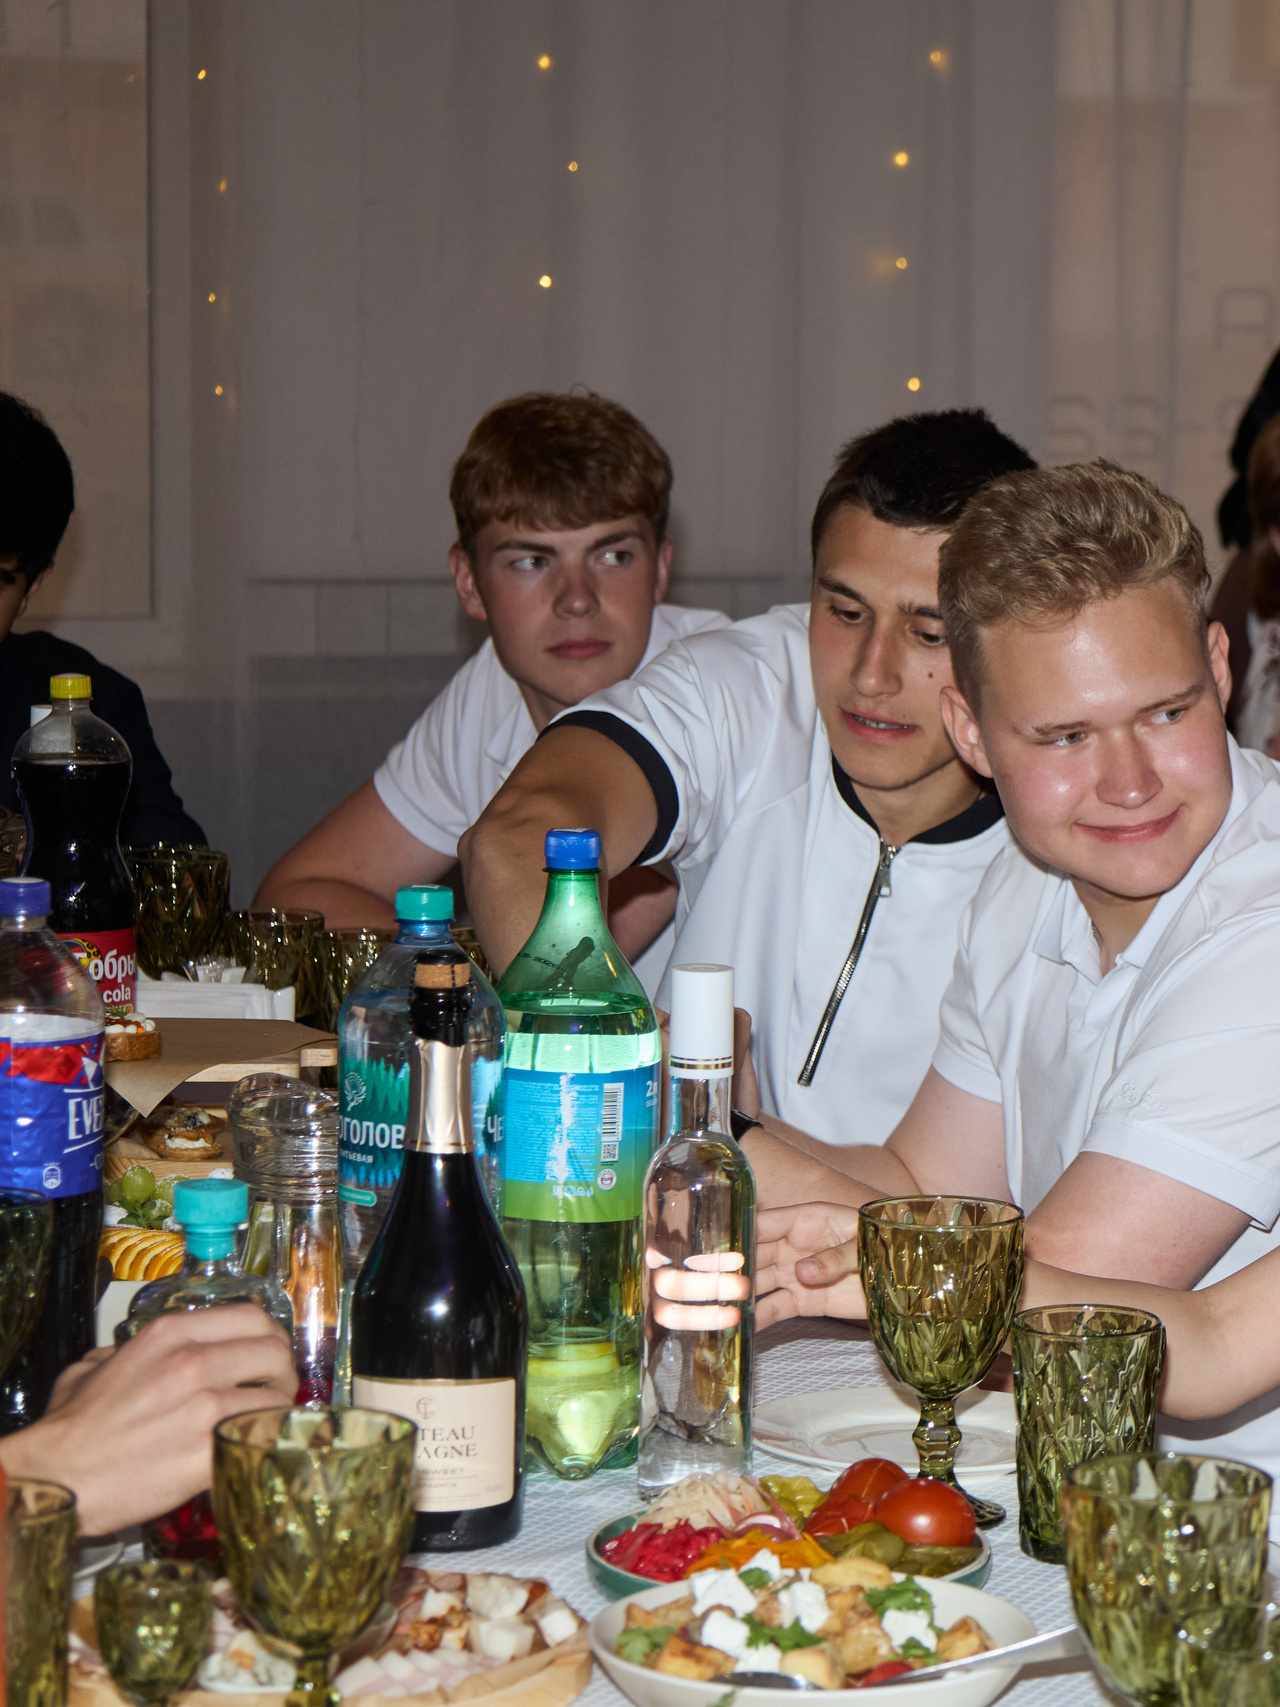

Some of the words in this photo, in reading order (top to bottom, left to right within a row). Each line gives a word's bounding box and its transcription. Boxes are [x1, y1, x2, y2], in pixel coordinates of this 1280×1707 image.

[103, 984, 131, 1003] cola
[68, 1095, 104, 1140] EVE
[420, 1426, 475, 1441] TEAU
[417, 1444, 478, 1459] AGNE
